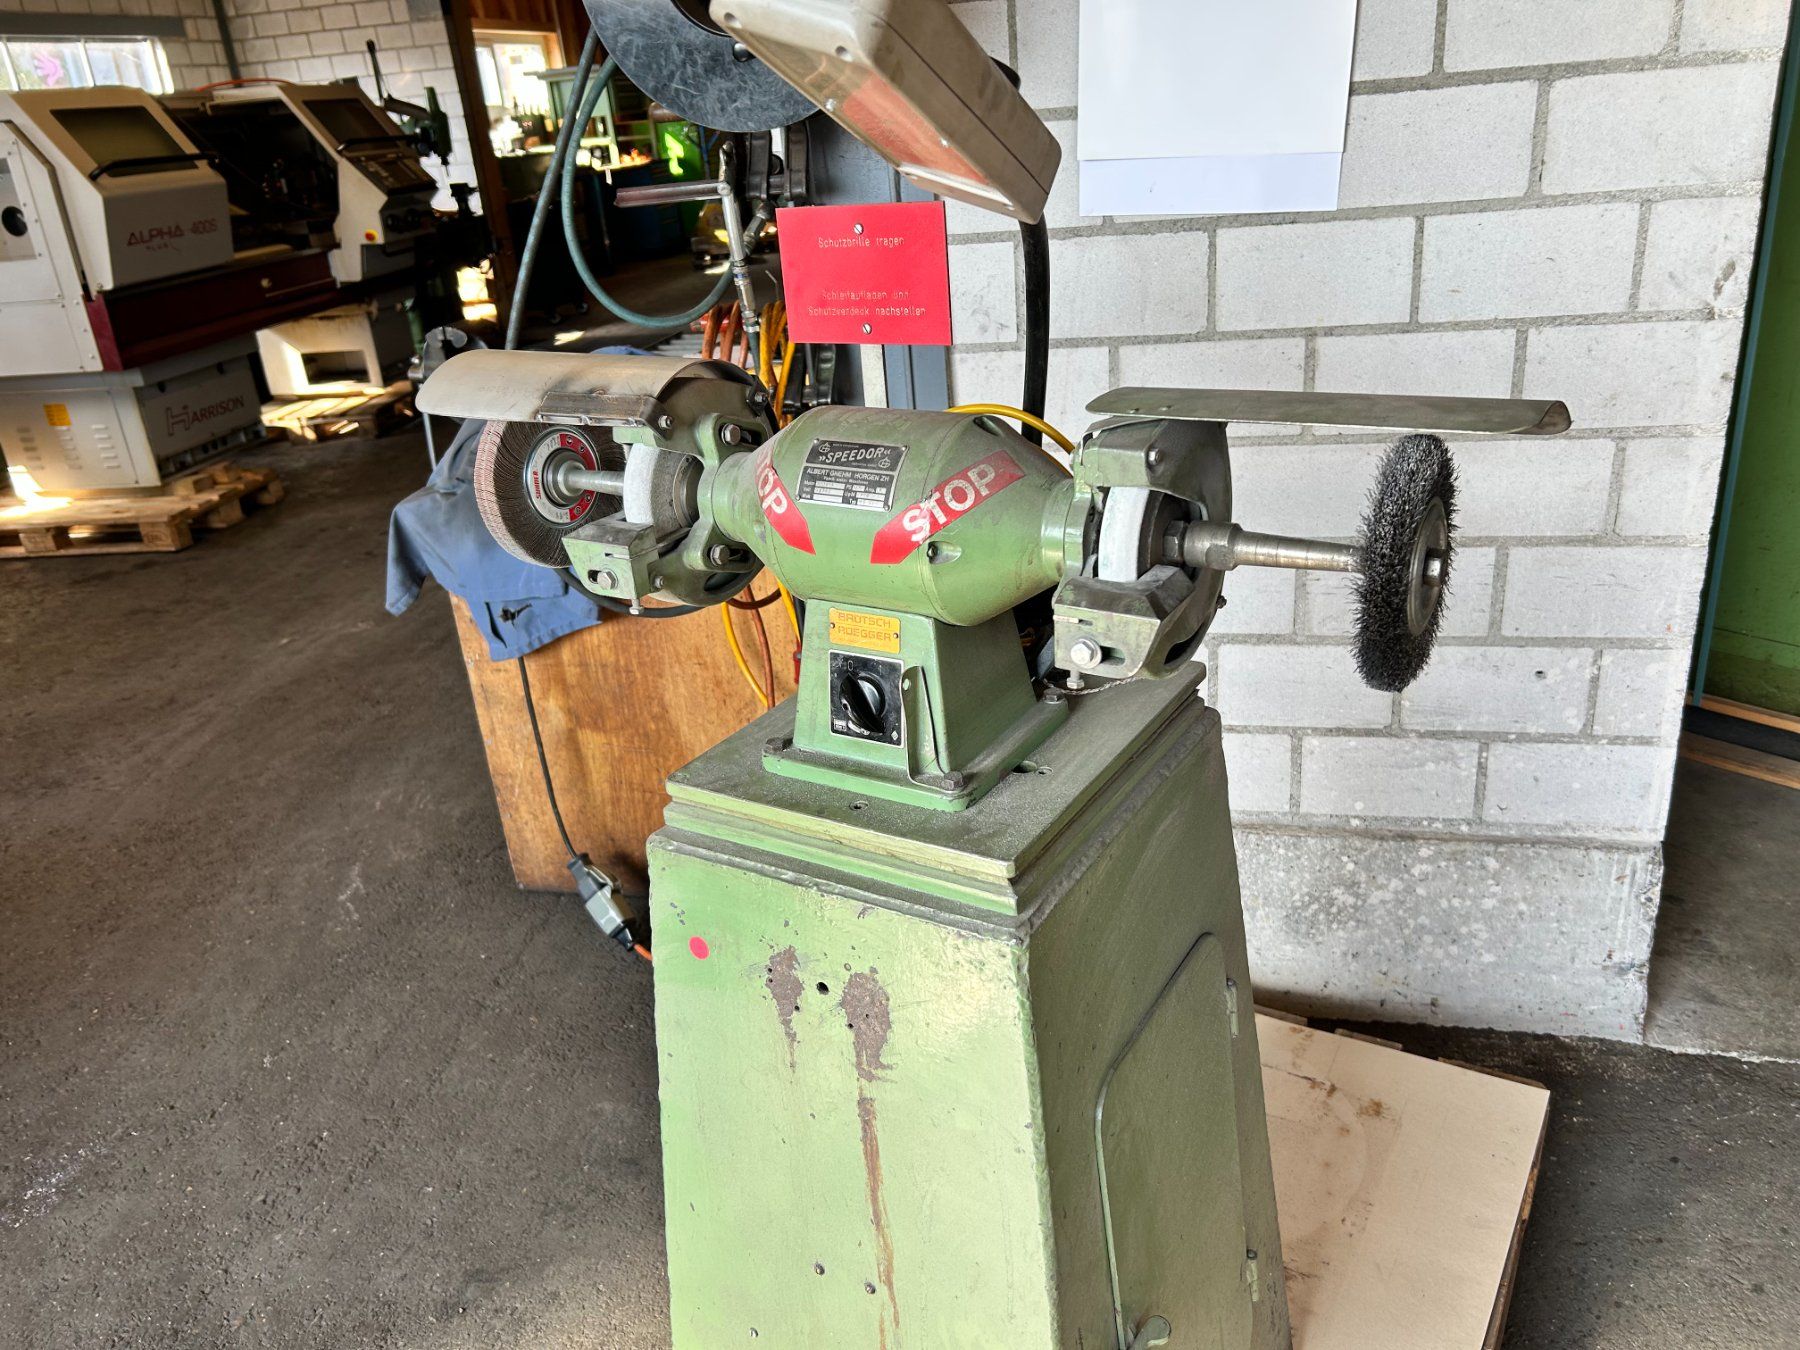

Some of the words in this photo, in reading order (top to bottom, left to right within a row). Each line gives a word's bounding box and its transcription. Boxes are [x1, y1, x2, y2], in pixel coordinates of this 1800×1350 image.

[127, 225, 185, 247] ALPHA
[818, 236, 870, 248] Schutzbrille
[876, 236, 905, 248] tragen
[807, 305, 869, 316] Schutzverdeck
[875, 305, 927, 317] nachstellen
[166, 394, 244, 437] HARRISON
[806, 468, 829, 476] ALBERT
[854, 472, 879, 481] HORGEN
[902, 463, 996, 542] STOP
